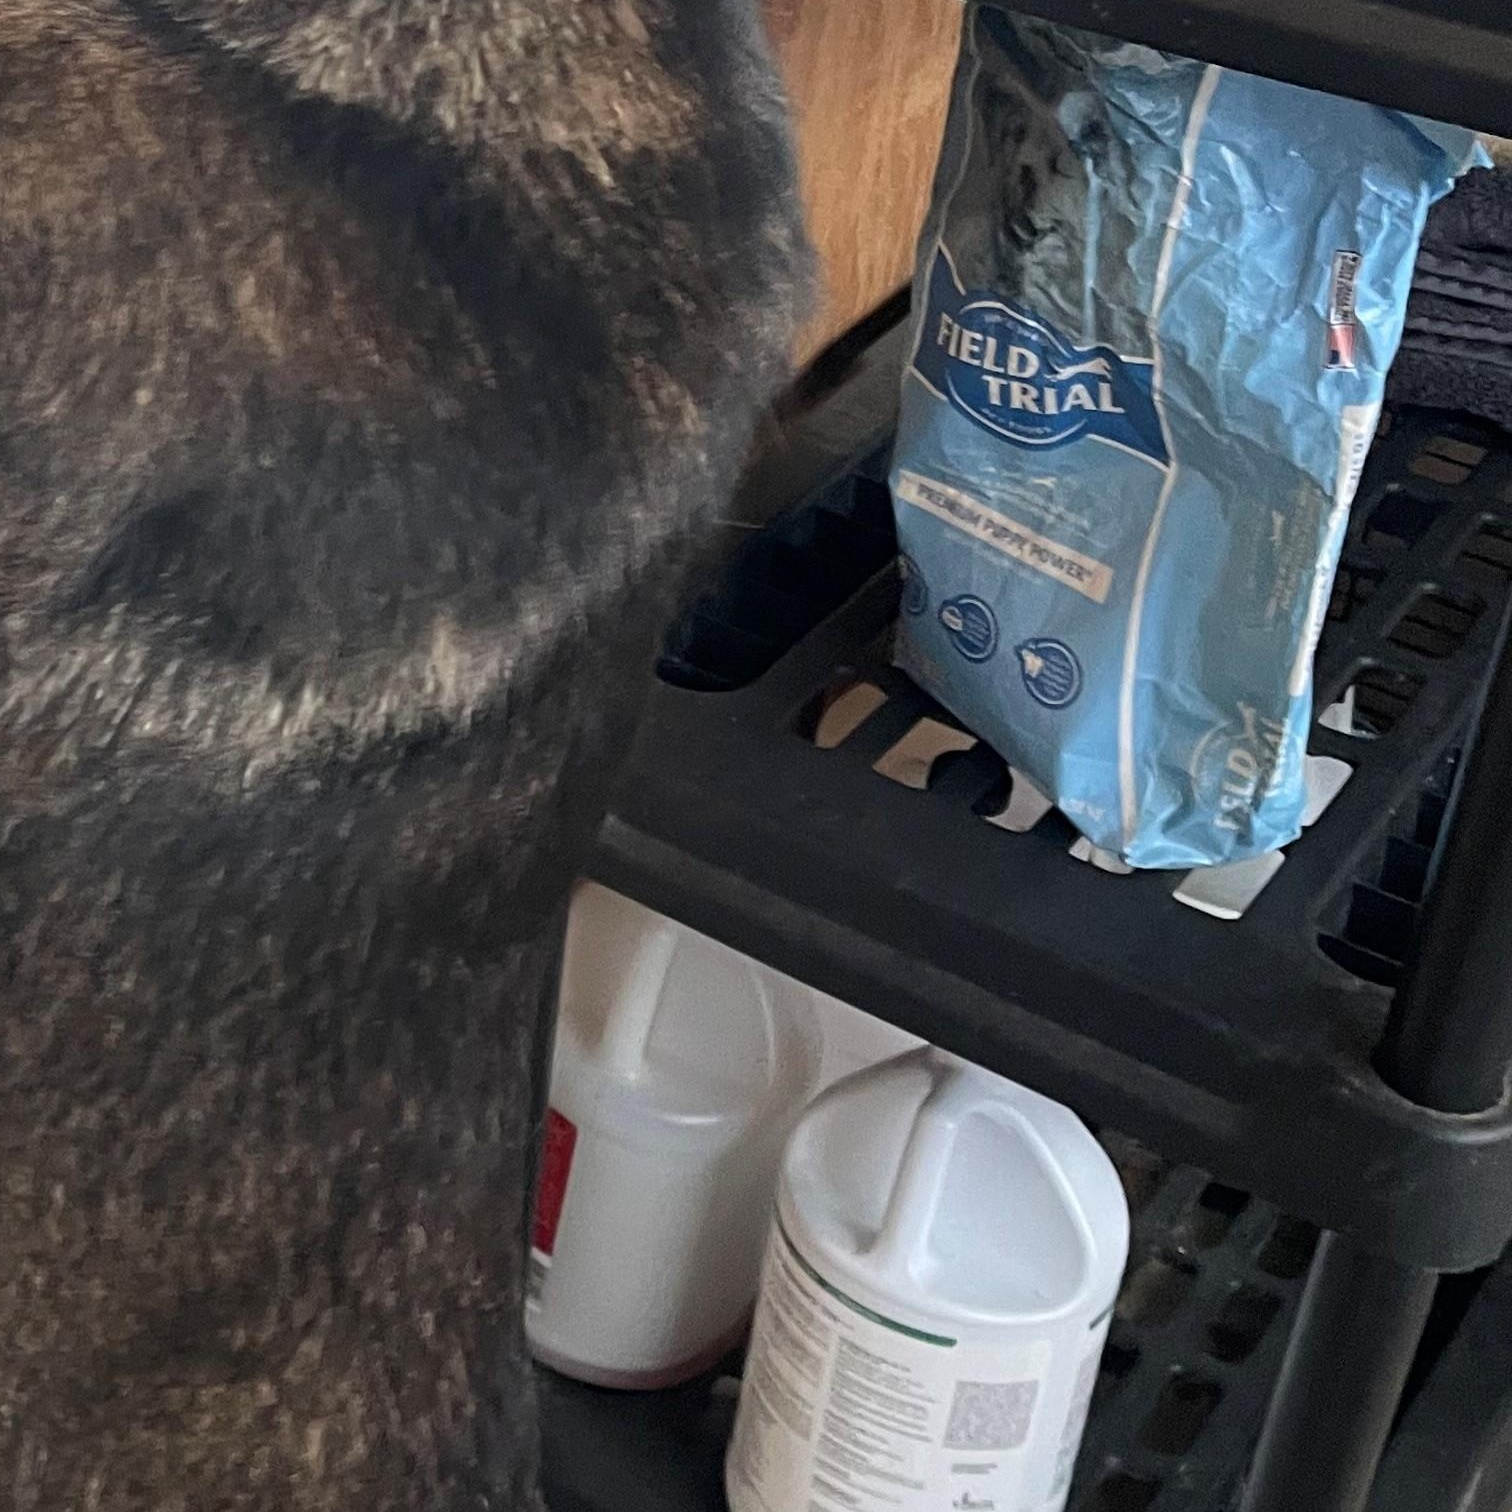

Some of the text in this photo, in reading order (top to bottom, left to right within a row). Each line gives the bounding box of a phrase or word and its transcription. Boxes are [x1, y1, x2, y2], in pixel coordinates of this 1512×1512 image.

[936, 311, 1041, 380] FIELD
[980, 373, 1128, 416] TRIAL
[917, 482, 983, 527] PREMIUM
